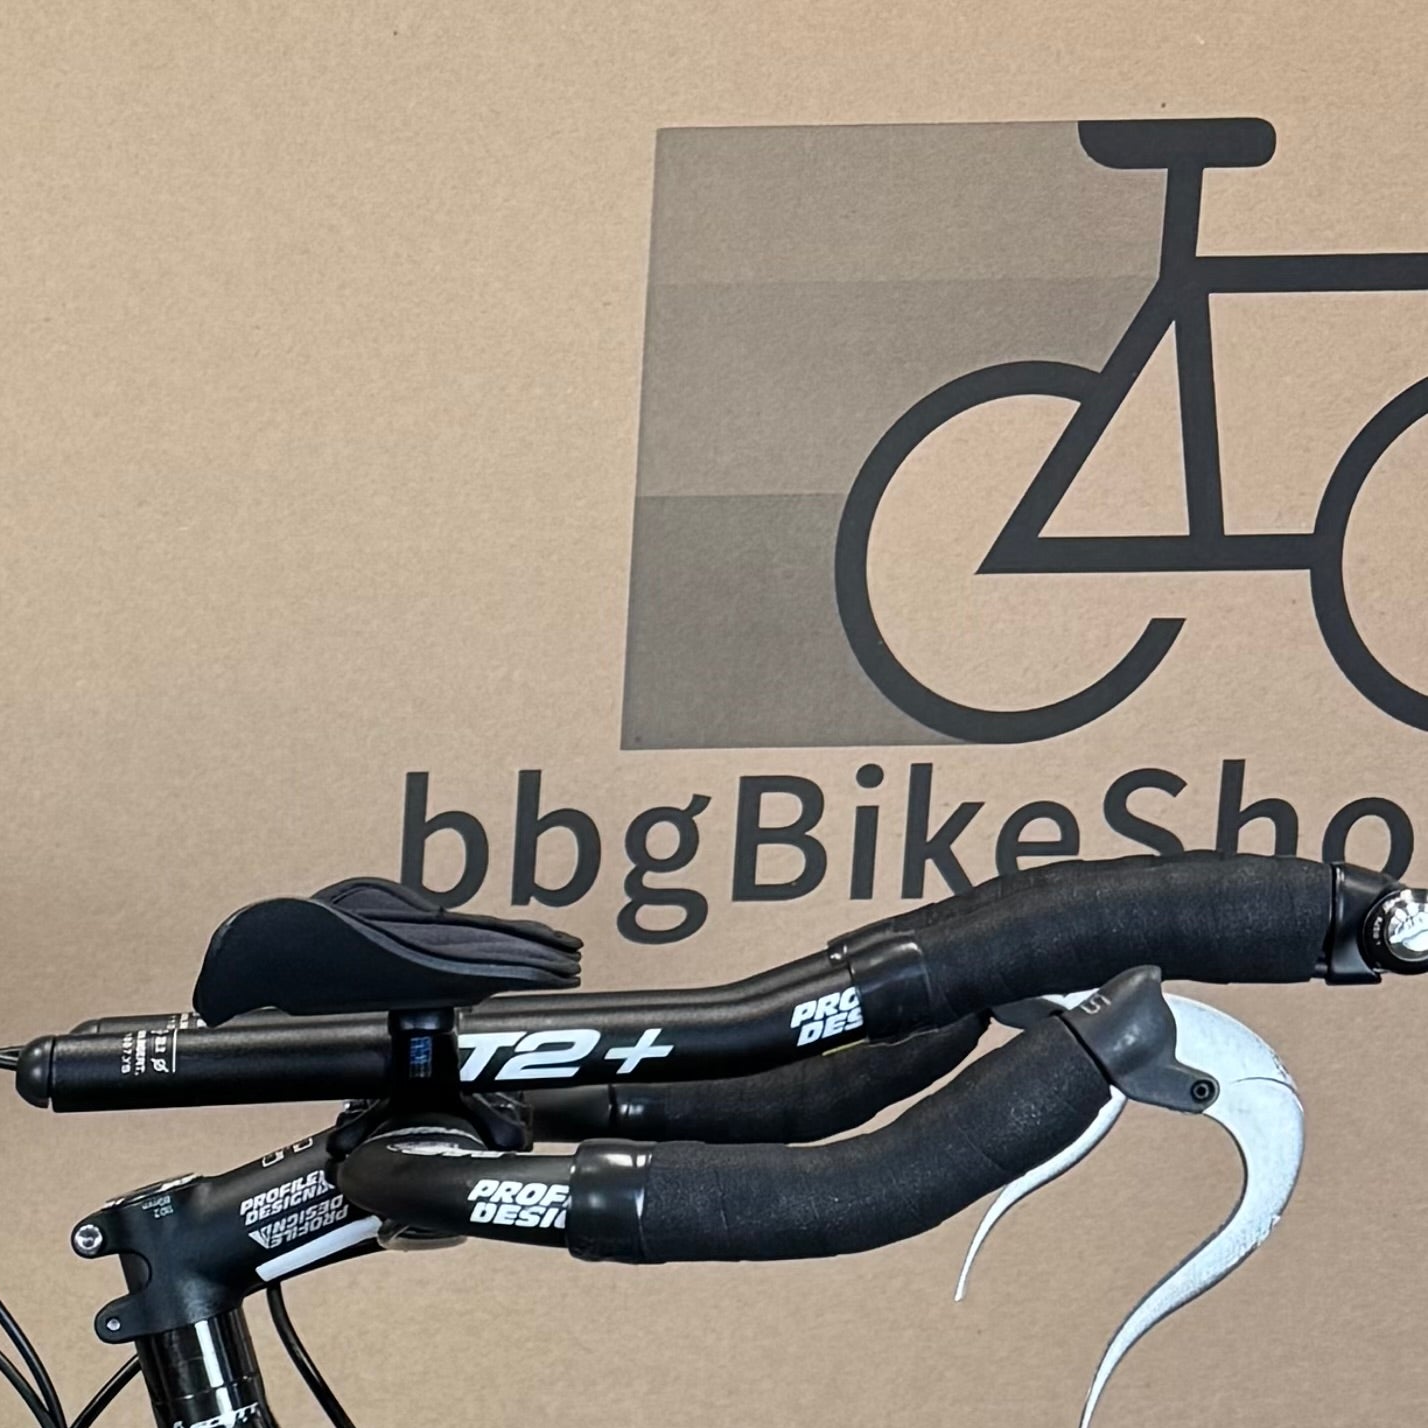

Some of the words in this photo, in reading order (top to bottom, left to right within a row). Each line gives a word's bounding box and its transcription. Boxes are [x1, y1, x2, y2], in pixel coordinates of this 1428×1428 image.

[239, 1170, 320, 1216] PROFILE
[244, 1184, 317, 1226] DESIGN
[467, 1178, 572, 1207] PROF
